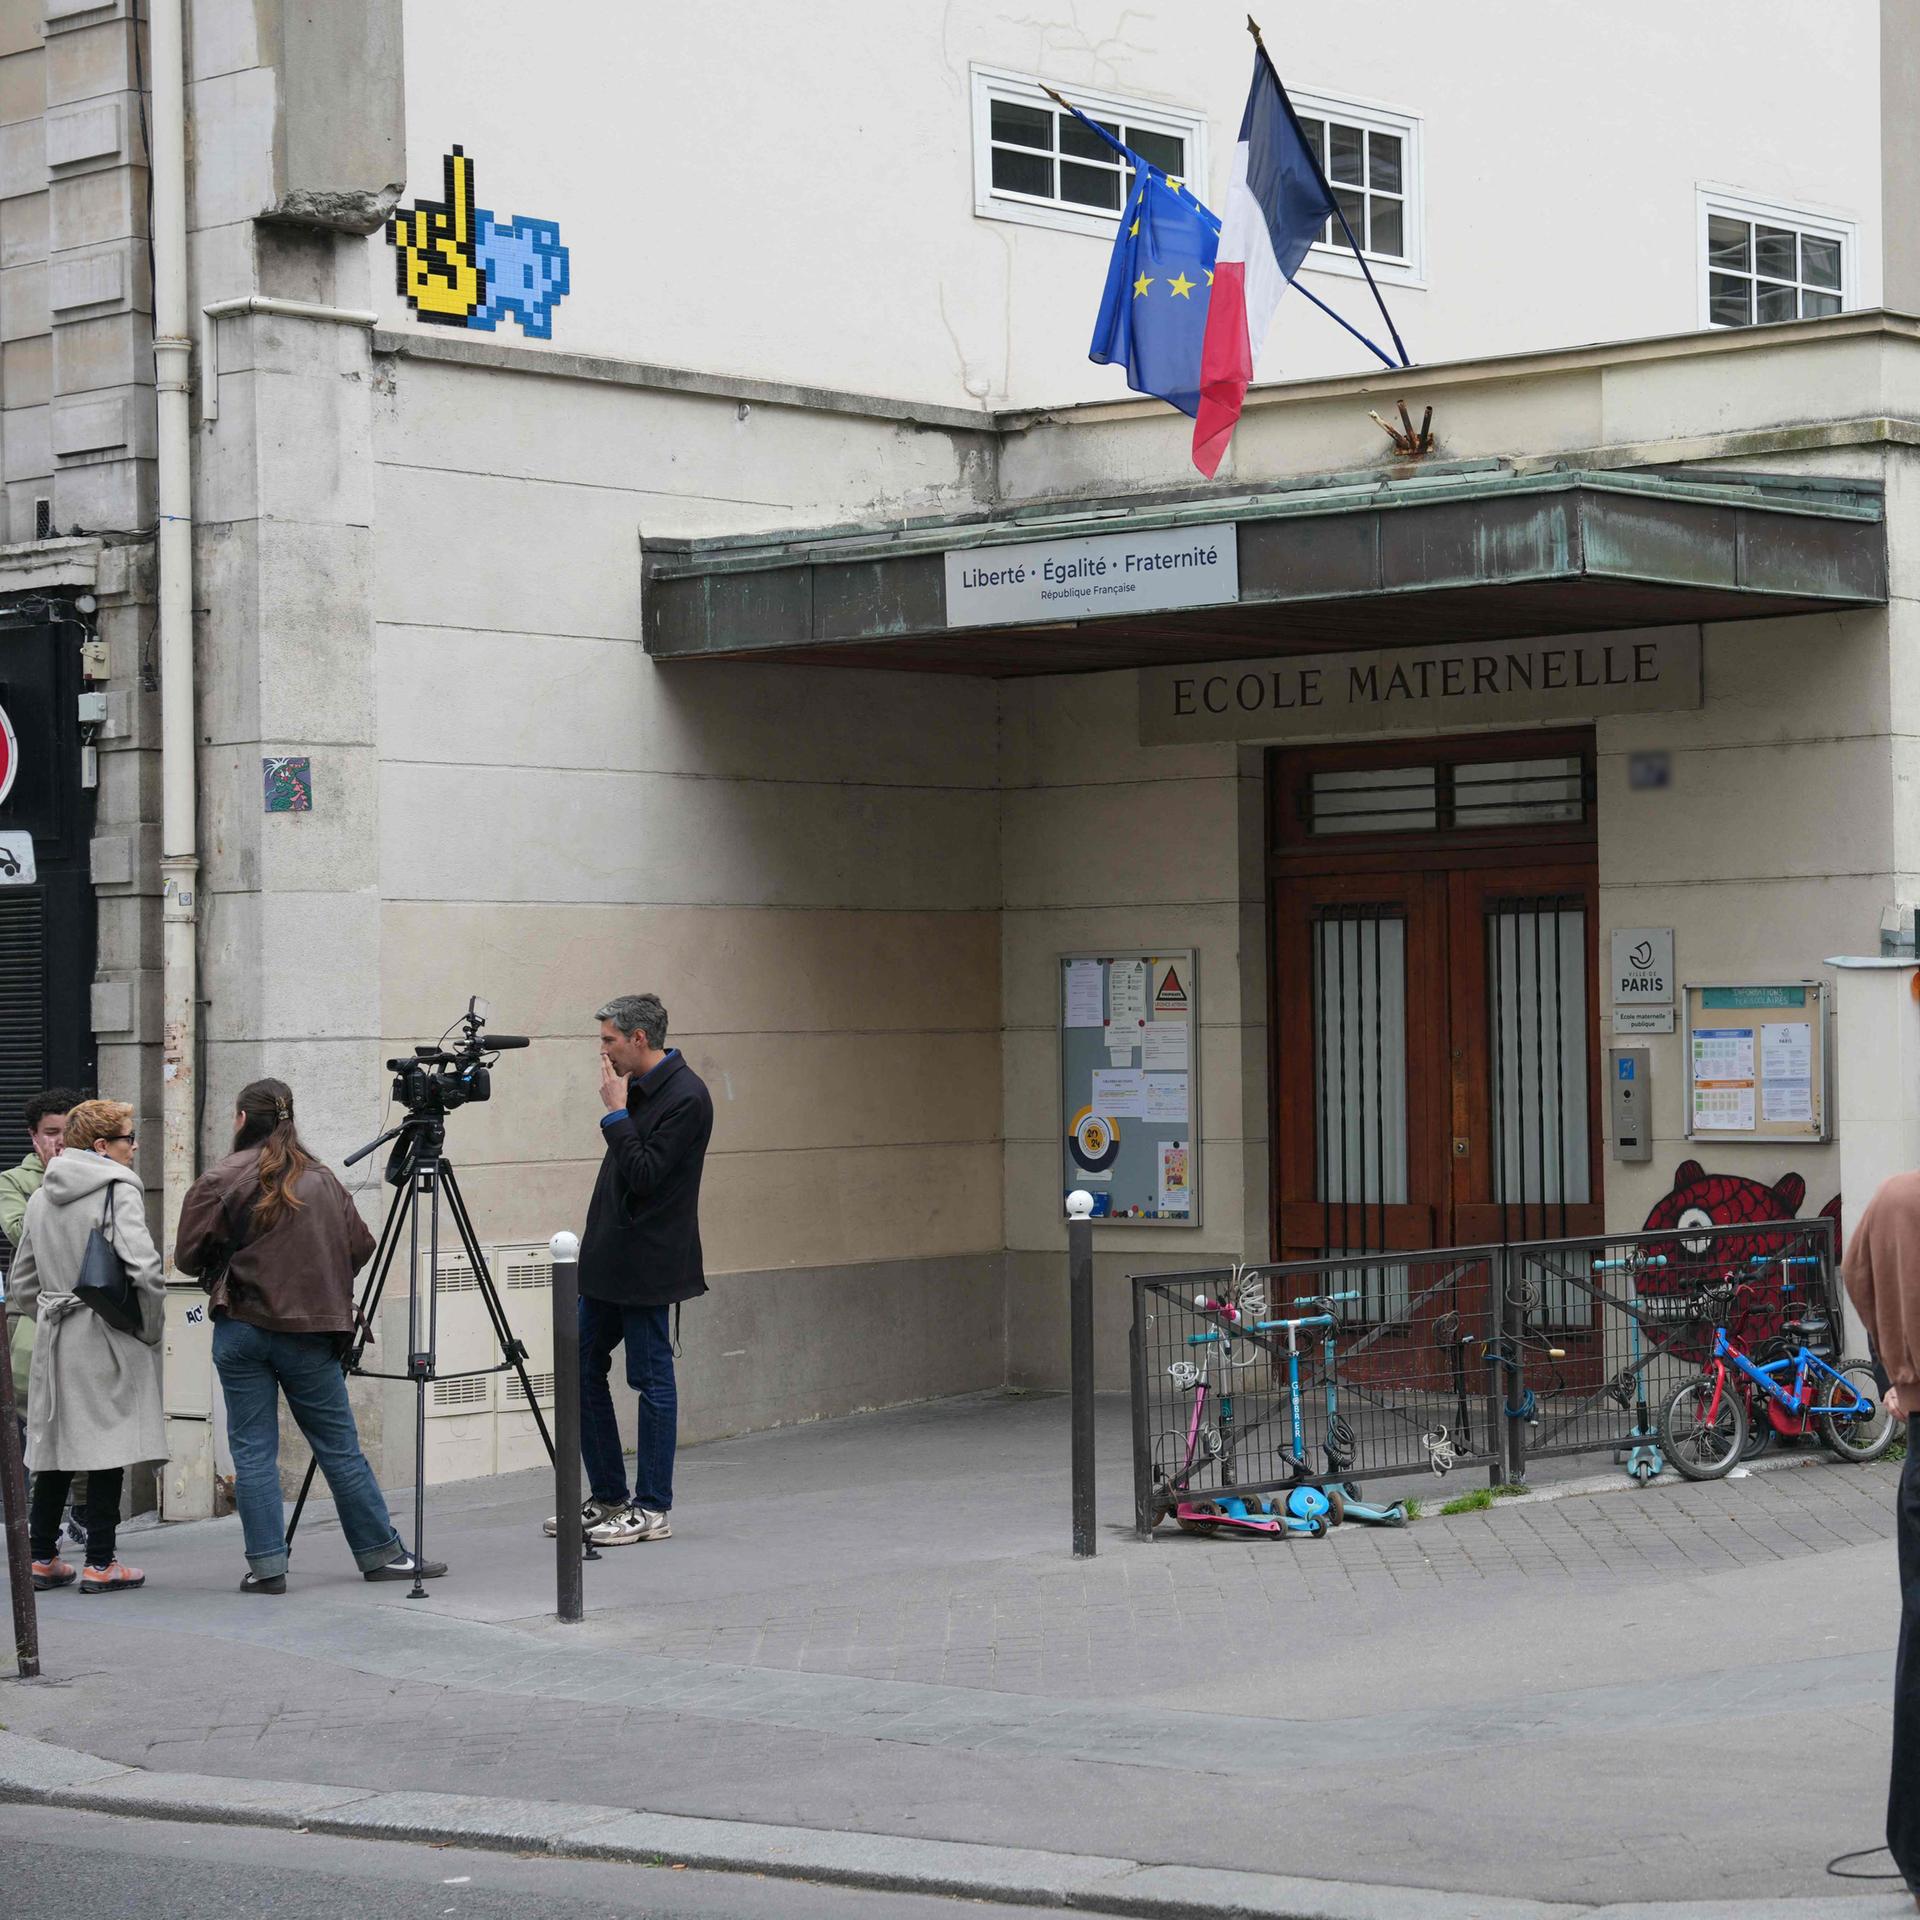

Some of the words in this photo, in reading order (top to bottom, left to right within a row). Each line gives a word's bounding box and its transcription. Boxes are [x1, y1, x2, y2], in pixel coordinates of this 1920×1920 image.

[963, 564, 1026, 589] Liberté
[1043, 557, 1107, 584] Égalité
[1125, 545, 1218, 572] Fraternité
[1041, 586, 1092, 600] République
[1093, 583, 1136, 597] Française
[1173, 669, 1324, 716] ECOLE
[1348, 643, 1660, 703] MATERNELLE
[1621, 977, 1664, 992] PARIS
[1636, 1012, 1666, 1020] maternelle
